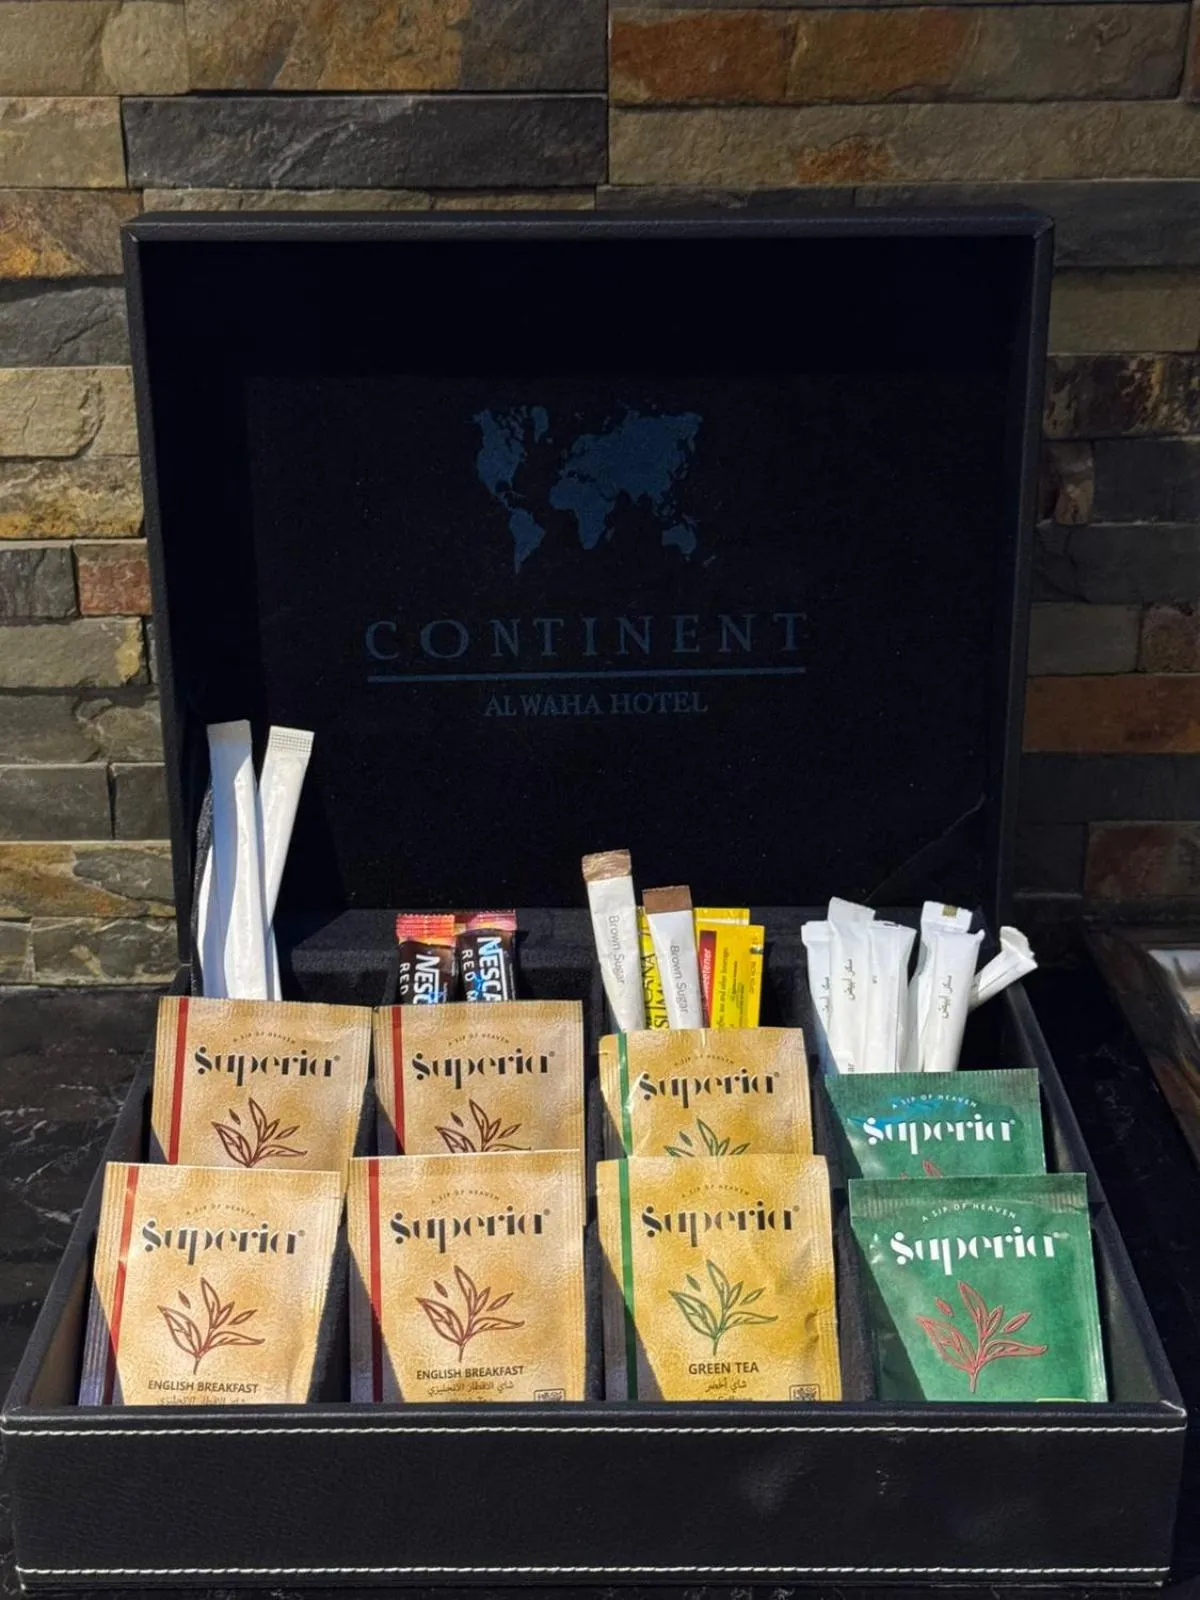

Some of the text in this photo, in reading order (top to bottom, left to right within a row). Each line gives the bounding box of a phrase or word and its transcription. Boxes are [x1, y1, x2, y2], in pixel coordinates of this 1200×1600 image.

[364, 612, 808, 661] CONTINENT
[519, 693, 604, 717] WAHA
[609, 691, 709, 715] HOTEL
[608, 915, 625, 985] Brown Sugar
[461, 949, 476, 981] RED
[670, 944, 688, 1014] Brown Sugar
[931, 1206, 948, 1218] SIP
[953, 1203, 967, 1211] OF
[972, 1203, 1017, 1219] HEAVEN
[416, 1365, 525, 1381] ENGLISH BREAKFAST
[688, 1362, 760, 1375] GREEN TEA
[148, 1380, 259, 1393] ENGLISH BREAKFAST
[496, 1380, 514, 1393] شاي
[704, 1377, 747, 1392] شاي أخضر
